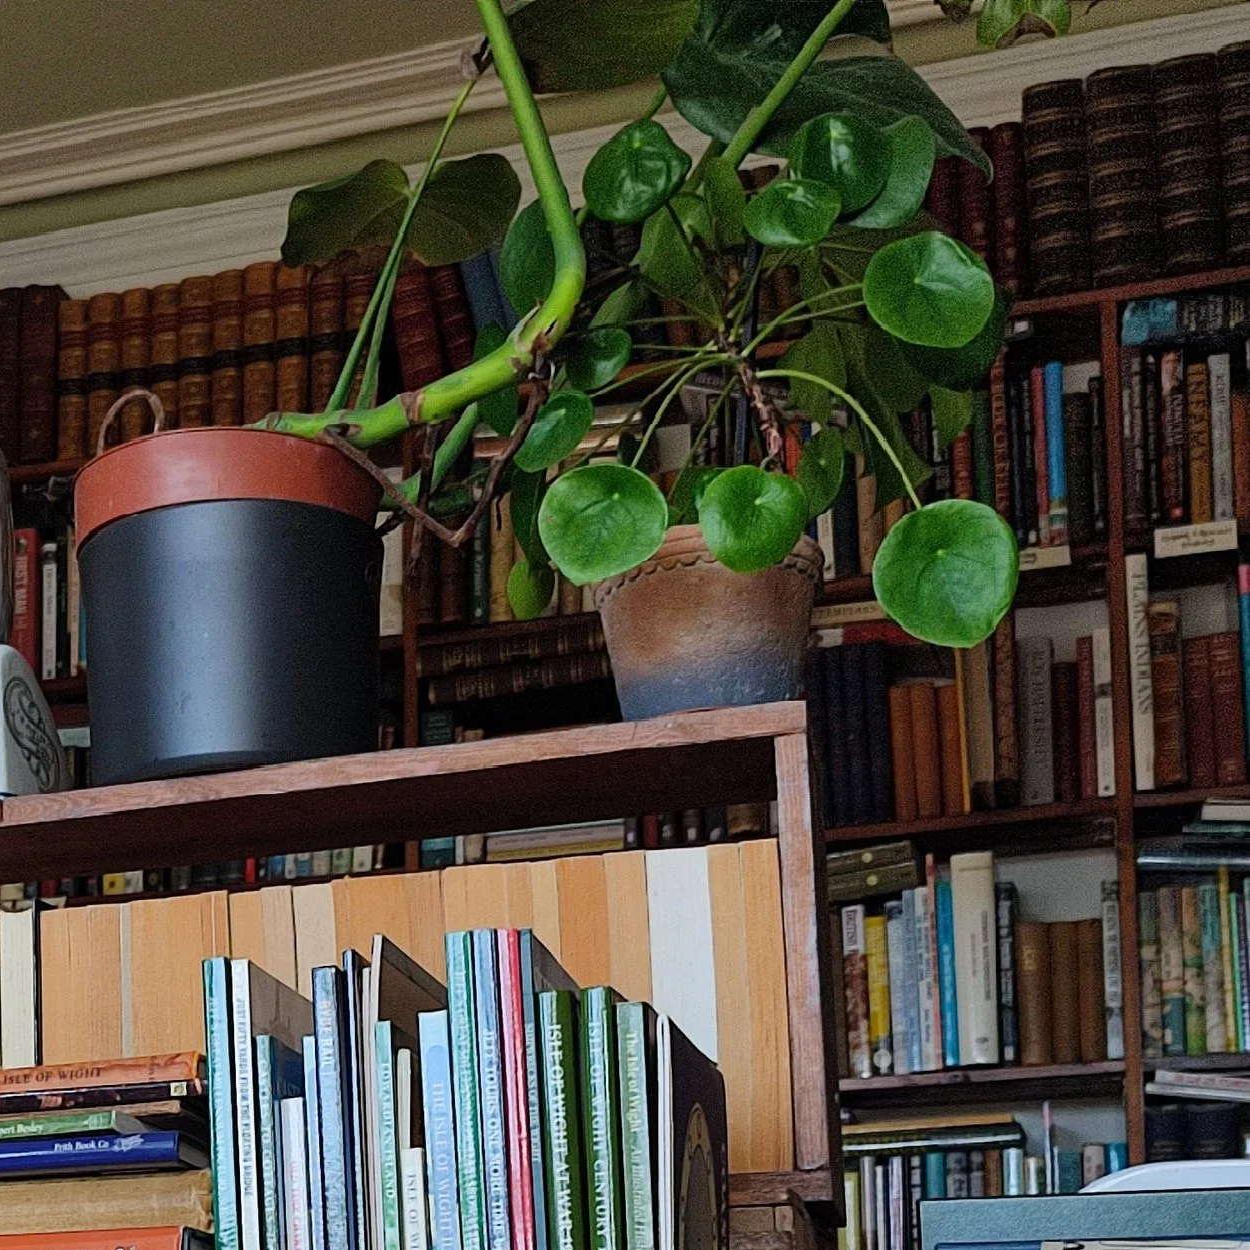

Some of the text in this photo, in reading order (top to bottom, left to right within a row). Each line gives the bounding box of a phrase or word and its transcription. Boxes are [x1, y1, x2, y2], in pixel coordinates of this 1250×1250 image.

[1131, 573, 1151, 715] PLAINS INDIANS
[237, 999, 247, 1020] JUST
[319, 1000, 332, 1034] RYDE
[238, 1023, 248, 1045] FIFTY
[483, 1028, 495, 1058] JEFF
[549, 1024, 563, 1061] ISLE
[588, 1022, 601, 1060] ISLE
[626, 1032, 638, 1056] The
[239, 1047, 249, 1074] YARDS
[321, 1037, 334, 1069] RAIL
[627, 1056, 640, 1078] Isle
[3, 1072, 30, 1085] ISLE
[36, 1071, 52, 1083] OF
[58, 1067, 102, 1080] WIGHT
[240, 1077, 250, 1101] FROM
[259, 1059, 271, 1120] CASTLES
[485, 1066, 497, 1115] TOURS
[551, 1065, 565, 1090] OF
[590, 1065, 603, 1087] OF
[629, 1080, 640, 1093] of
[241, 1105, 251, 1121] THE
[381, 1062, 394, 1146] EDWARDIAN
[432, 1082, 444, 1112] THE
[529, 1107, 540, 1125] THE
[553, 1093, 568, 1158] WIGHT
[591, 1093, 606, 1152] WIGHT
[626, 1096, 642, 1132] Wight
[54, 1141, 74, 1152] Frith
[75, 1140, 97, 1151] Book
[98, 1141, 109, 1150] Co
[242, 1123, 252, 1162] FLOATING
[262, 1126, 273, 1143] TO
[435, 1116, 447, 1150] ISLE
[487, 1118, 500, 1151] ONE
[437, 1153, 449, 1173] OF
[631, 1145, 643, 1163] An
[244, 1165, 254, 1197] BRIDGE
[263, 1151, 275, 1221] COTTAGES
[384, 1150, 396, 1199] ISLAND
[406, 1173, 417, 1202] ISLE
[490, 1153, 502, 1197] MORE
[556, 1160, 570, 1186] AT
[438, 1179, 452, 1232] WIGHT
[594, 1159, 609, 1237] CENTURY
[632, 1164, 648, 1223] Illustrated
[408, 1209, 418, 1225] OF
[491, 1200, 504, 1236] TIME
[558, 1190, 573, 1234] WAR
